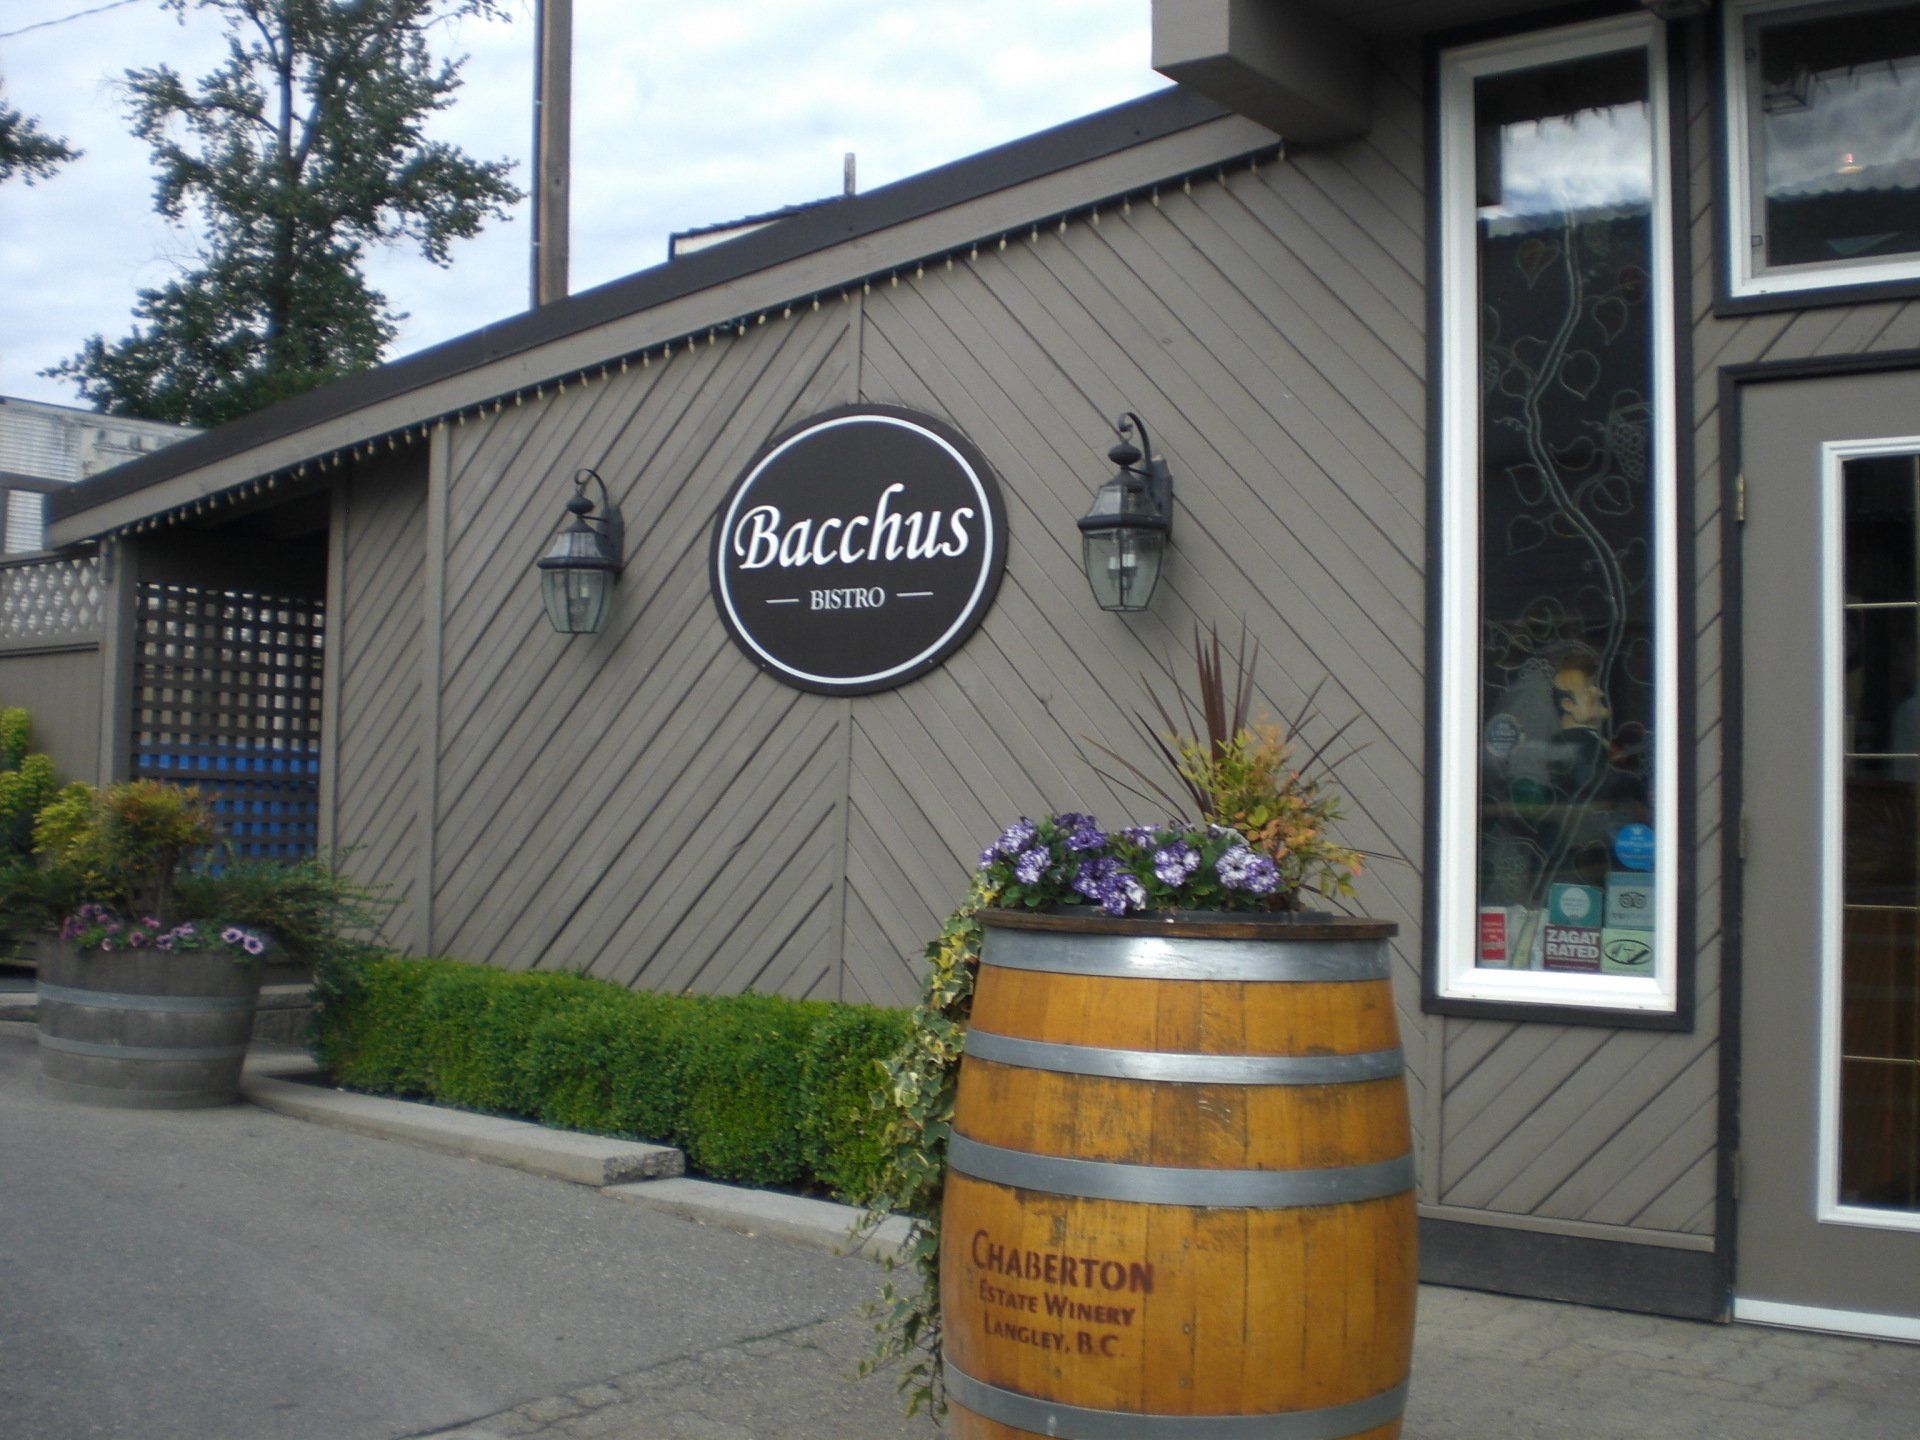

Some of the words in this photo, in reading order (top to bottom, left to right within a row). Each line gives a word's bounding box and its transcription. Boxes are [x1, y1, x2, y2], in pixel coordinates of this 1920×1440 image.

[734, 482, 974, 570] Bacchus
[810, 586, 886, 610] BISTRO
[1547, 943, 1600, 959] RATED
[1548, 929, 1600, 945] ZAGAT
[972, 1229, 1155, 1294] CHABERTON
[980, 1278, 1037, 1313] ESTATE
[1044, 1292, 1136, 1326] WINERY
